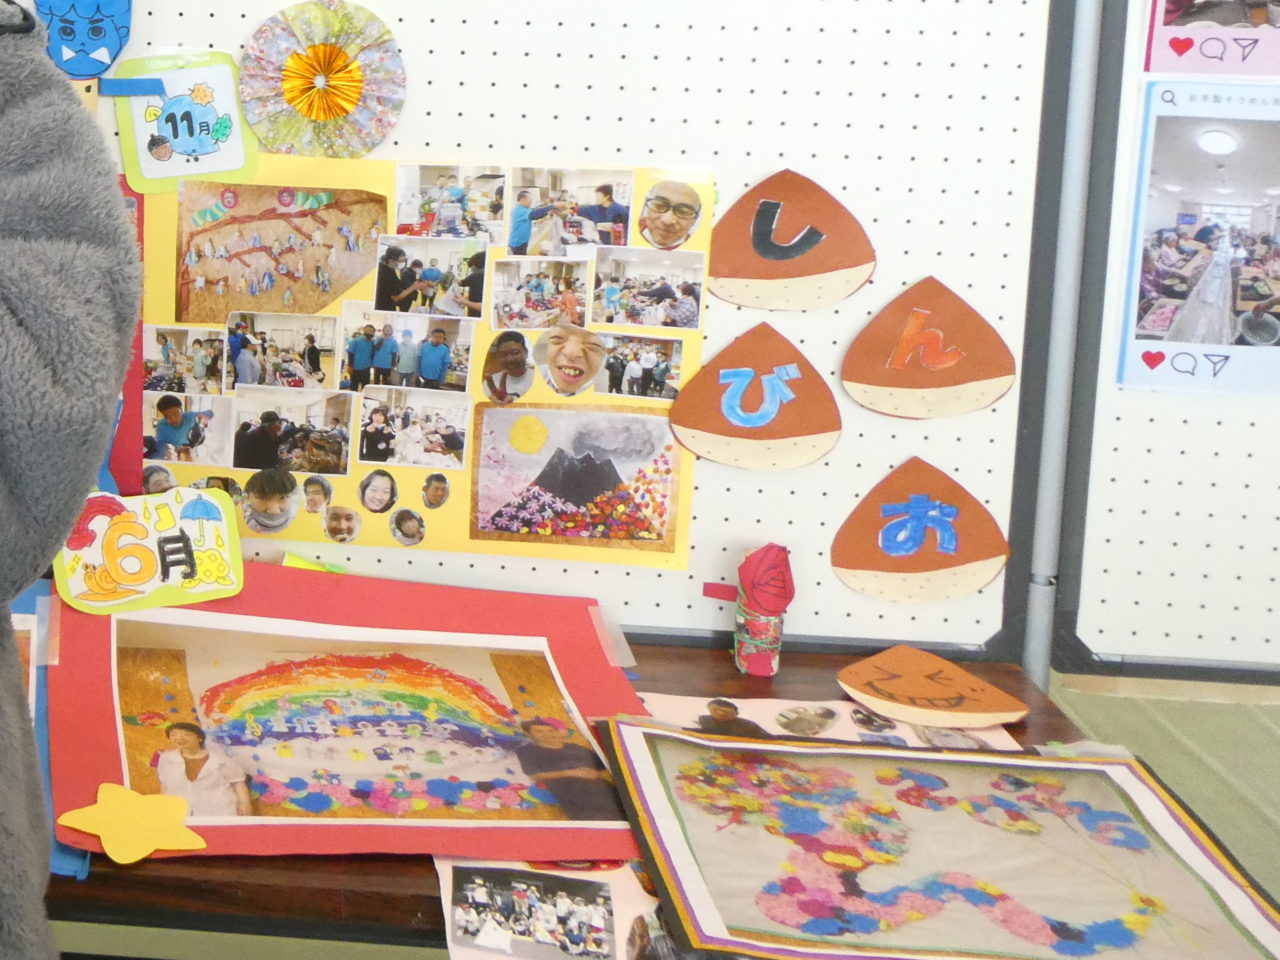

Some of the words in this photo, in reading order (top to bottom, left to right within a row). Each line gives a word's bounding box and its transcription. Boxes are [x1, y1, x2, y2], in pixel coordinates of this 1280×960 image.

[164, 111, 211, 140] 11月
[751, 198, 827, 261] し
[885, 308, 966, 371] ん
[719, 363, 802, 428] び
[101, 511, 197, 586] 6月
[878, 494, 958, 557] お
